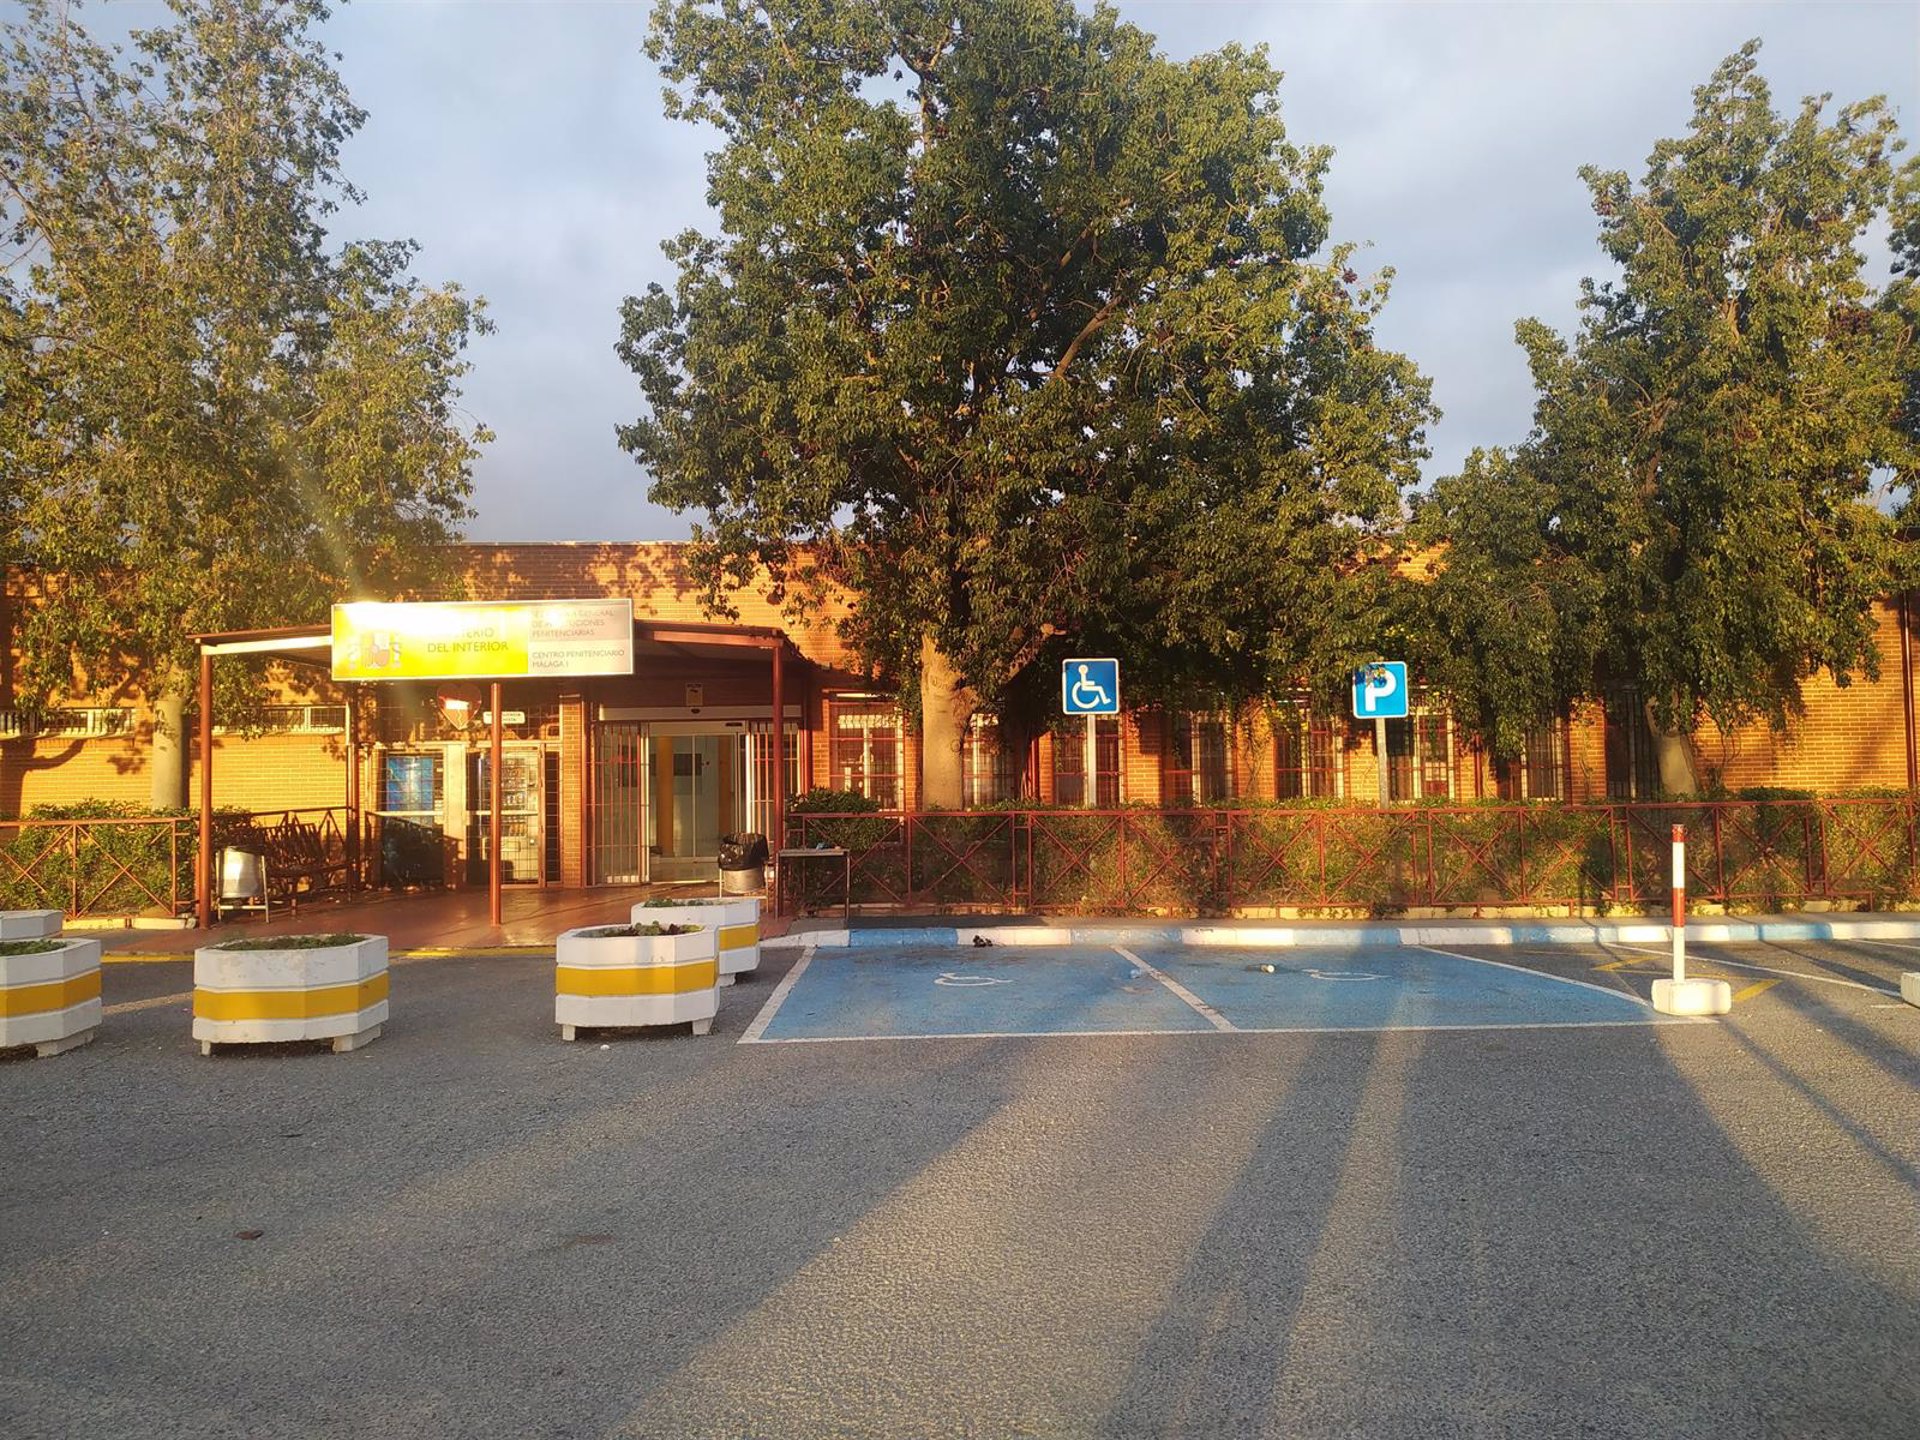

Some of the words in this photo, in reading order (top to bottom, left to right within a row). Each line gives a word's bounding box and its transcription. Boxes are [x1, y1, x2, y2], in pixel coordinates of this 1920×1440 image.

[427, 642, 449, 653] DEL
[452, 640, 509, 653] INTERIOR
[532, 650, 565, 659] CENTRO
[566, 649, 625, 658] PENITENCIARIO
[1365, 668, 1397, 712] P
